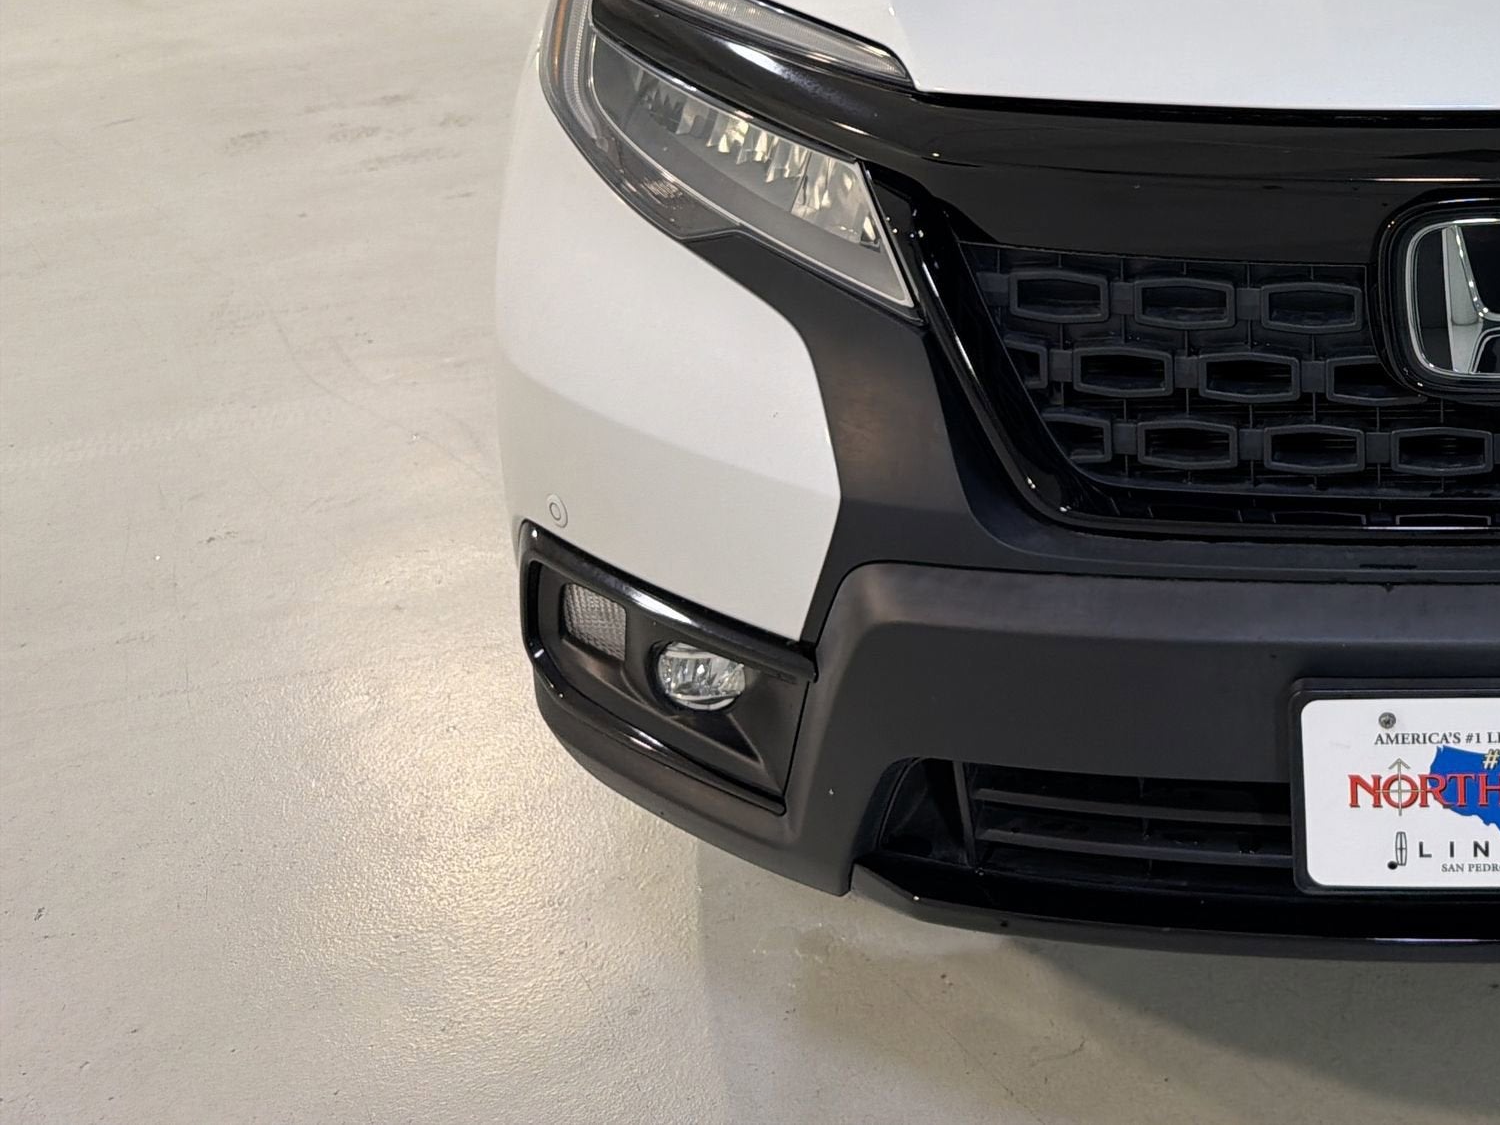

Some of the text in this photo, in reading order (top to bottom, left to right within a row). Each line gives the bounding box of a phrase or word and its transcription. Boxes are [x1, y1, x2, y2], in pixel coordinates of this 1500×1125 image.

[1374, 732, 1462, 745] AMERICA'S
[1465, 732, 1482, 744] #1
[1441, 863, 1465, 873] SAN
